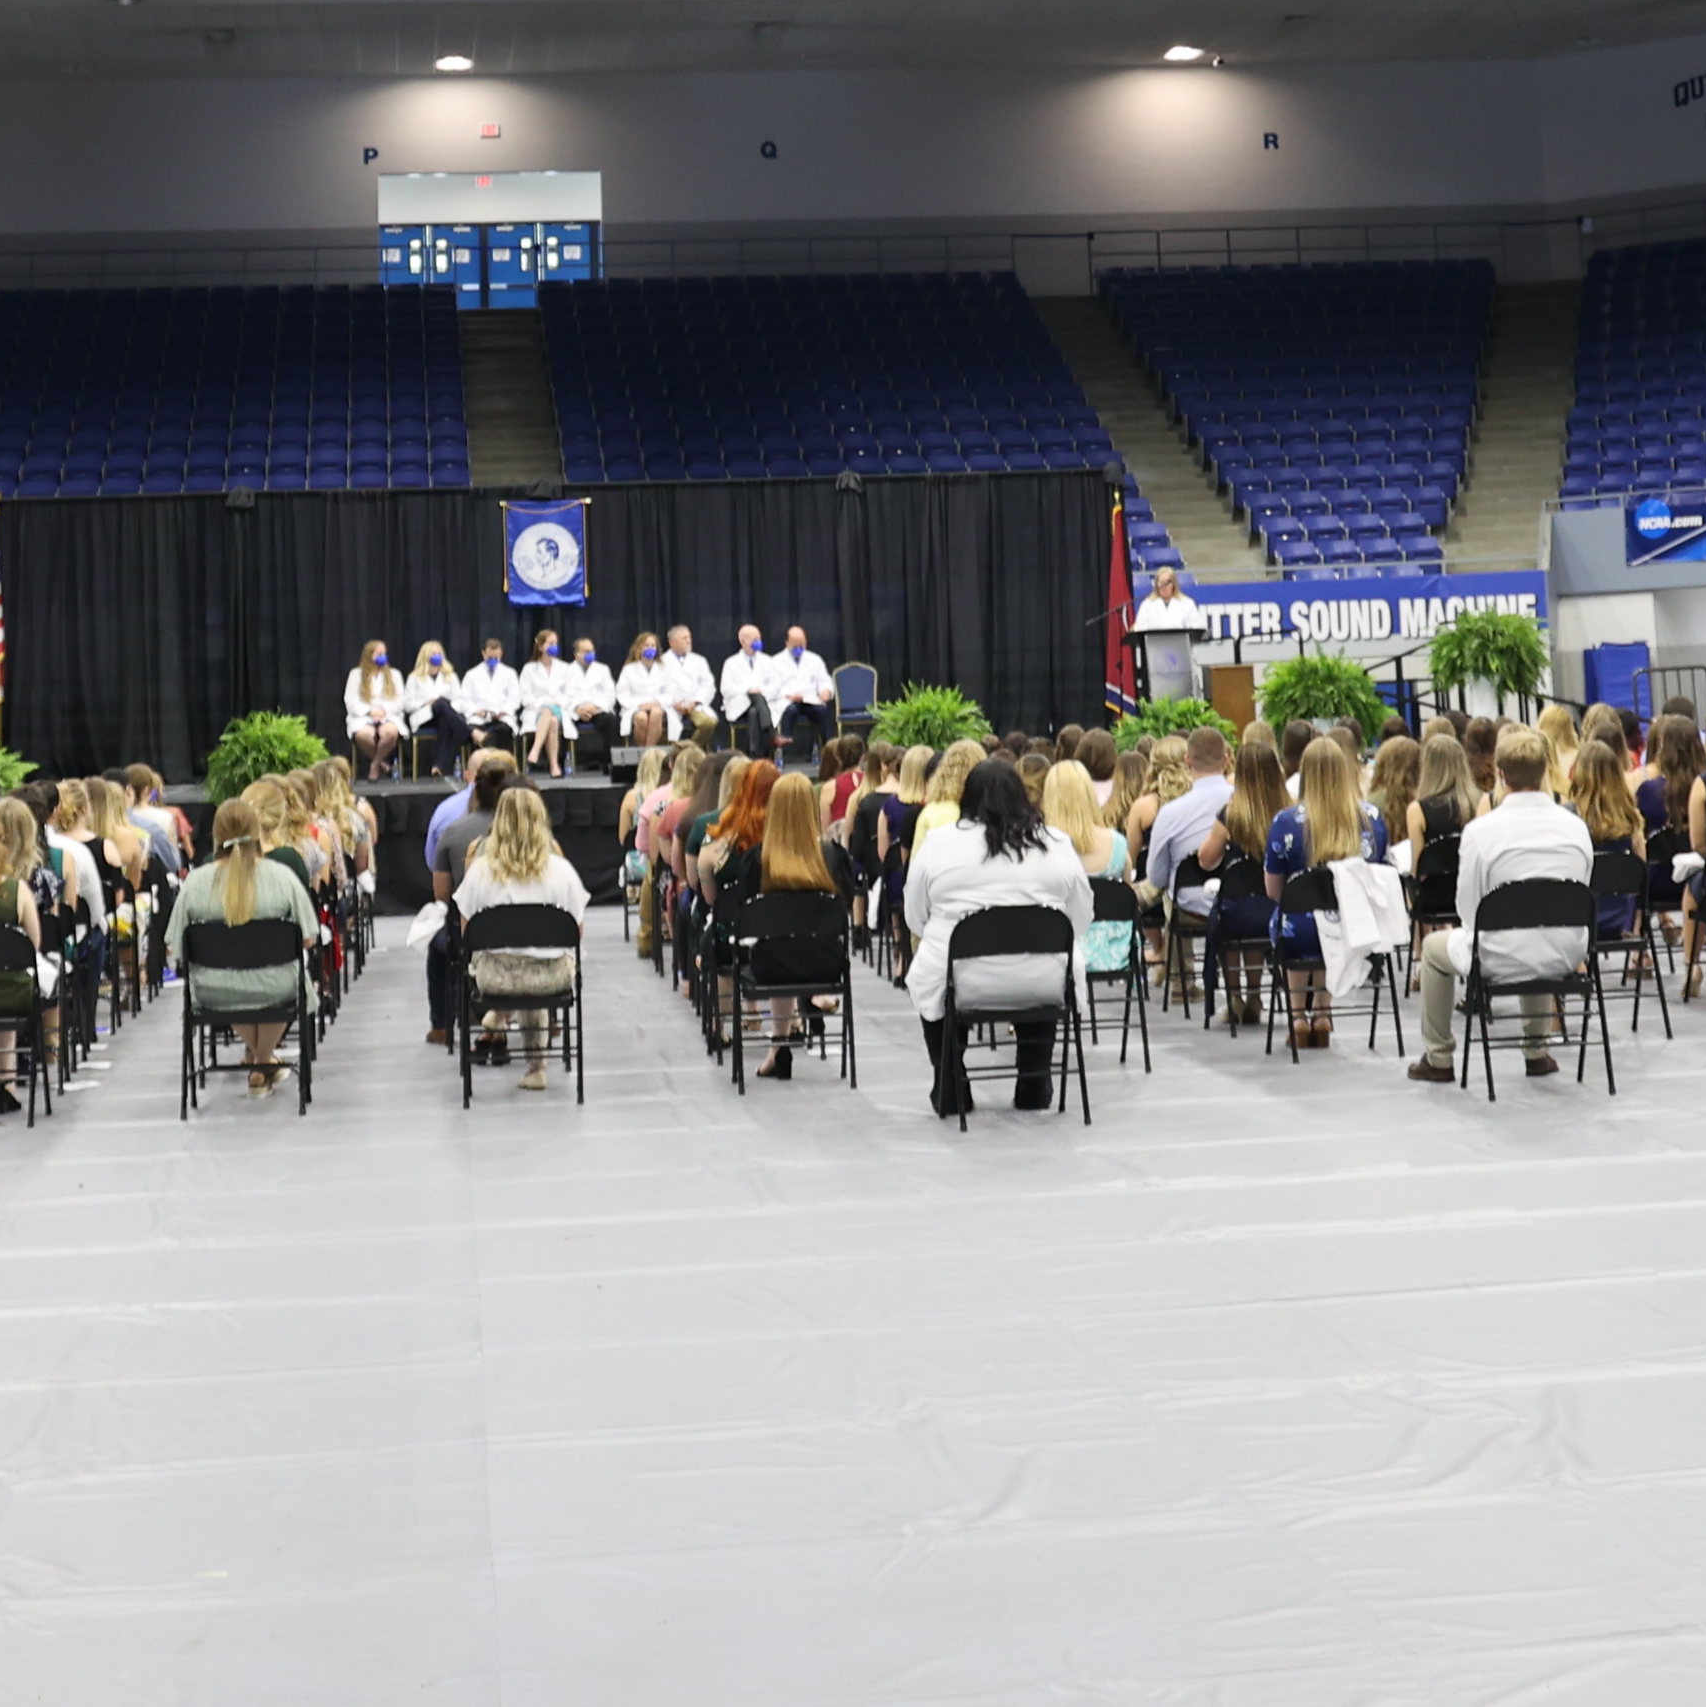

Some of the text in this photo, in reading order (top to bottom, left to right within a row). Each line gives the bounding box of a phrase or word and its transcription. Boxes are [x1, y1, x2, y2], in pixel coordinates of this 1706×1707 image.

[760, 140, 778, 159] Q
[1264, 132, 1279, 150] R
[362, 147, 379, 165] P
[1289, 598, 1392, 643] SOUND
